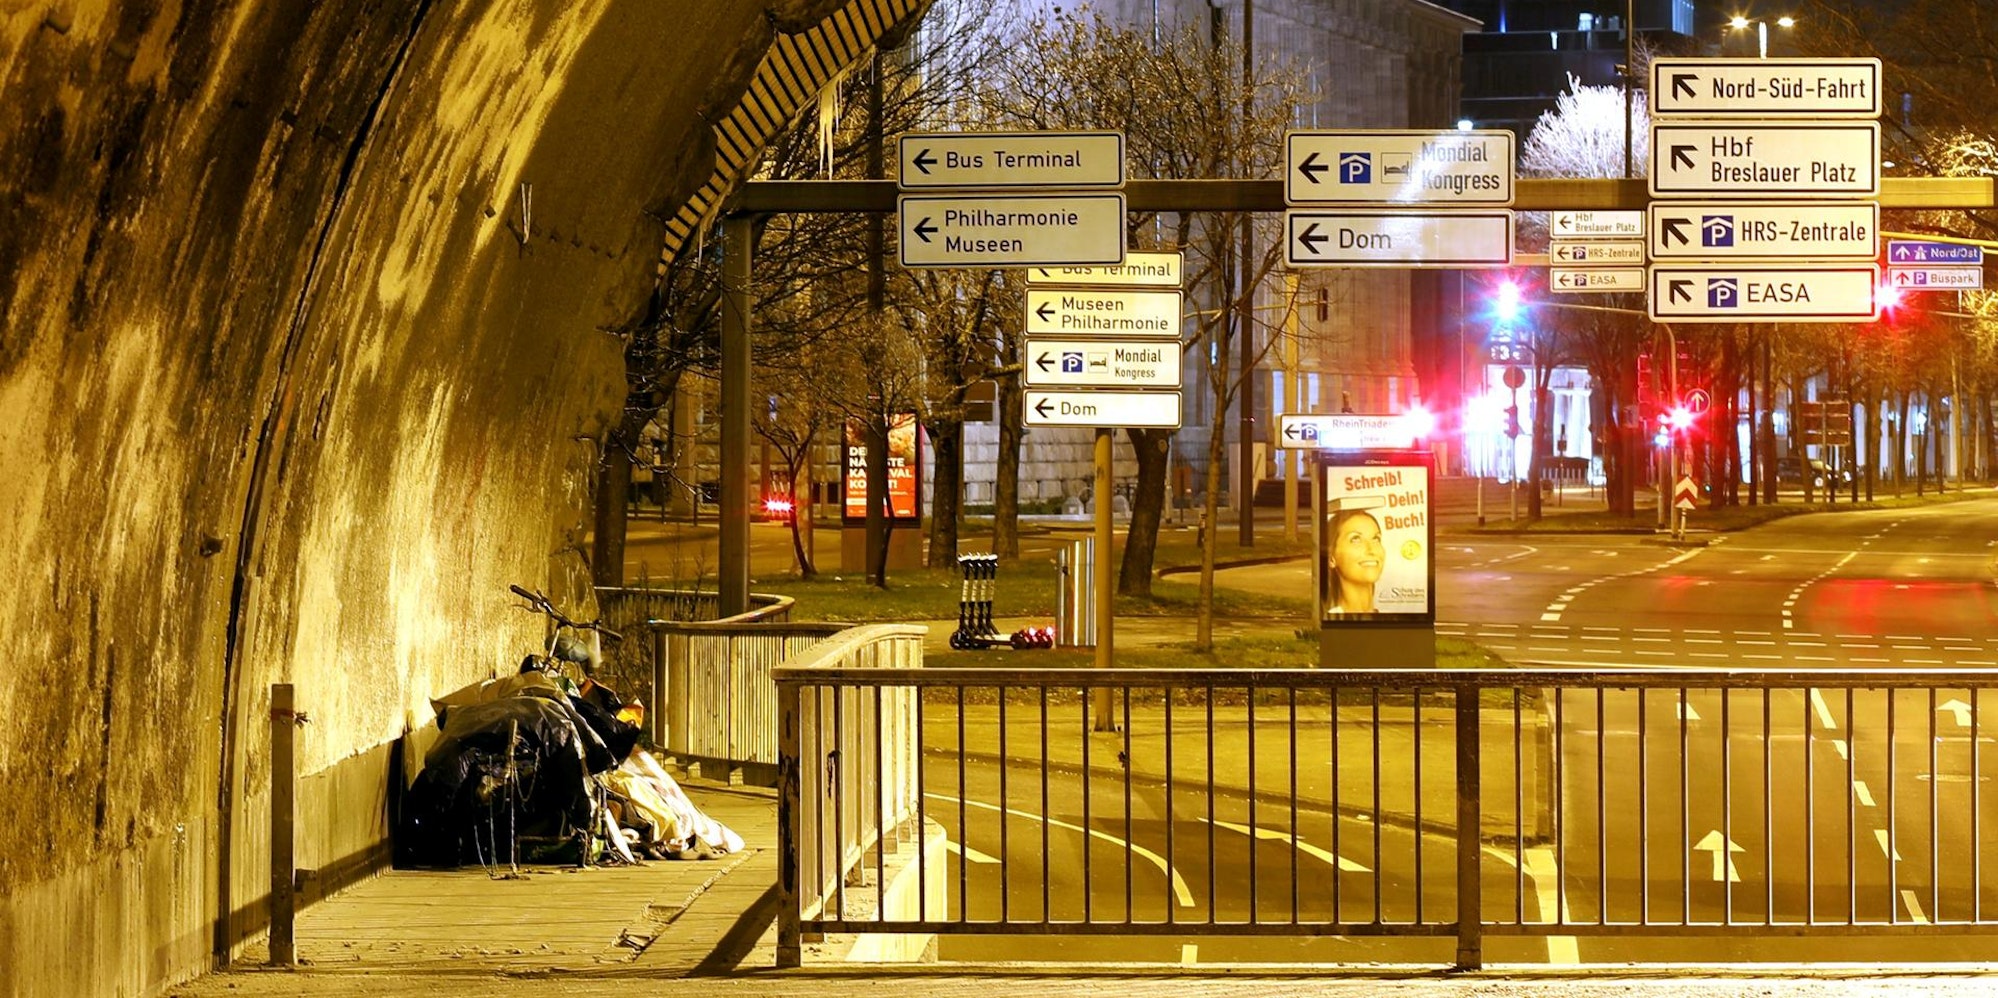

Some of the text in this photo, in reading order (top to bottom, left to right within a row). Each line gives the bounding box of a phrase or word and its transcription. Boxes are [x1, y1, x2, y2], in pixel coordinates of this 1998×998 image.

[1712, 77, 1866, 98] Nord-Süd-Fahrt
[1421, 140, 1488, 162] Mondial
[1711, 136, 1754, 157] Hbf
[946, 150, 1082, 168] Bus Terminal
[1711, 161, 1857, 182] Breslauer Platz
[1421, 170, 1500, 195] Kongress
[944, 209, 1079, 226] Philharmonie
[1575, 213, 1593, 222] Hbf
[1575, 222, 1636, 232] Breslauer Platz
[1742, 220, 1867, 241] HRS-Zentrale
[944, 235, 1023, 252] Museen
[1339, 228, 1392, 249] Dom
[1588, 248, 1640, 258] HRS-Zentrale
[1590, 275, 1617, 285] EASA
[1930, 273, 1975, 284] Buspark
[1747, 282, 1811, 303] EASA
[1062, 296, 1124, 311] Museen
[1062, 314, 1169, 330] Philharmonie
[1115, 348, 1162, 363] Mondial
[1115, 367, 1156, 380] Kongress
[1061, 401, 1097, 415] Dom
[1332, 418, 1394, 429] RheinTriade
[849, 446, 867, 456] DE
[849, 456, 904, 467] NÄTE
[849, 468, 912, 478] KAVAL
[1344, 471, 1403, 491] Schreib!
[849, 479, 898, 489] KOT!
[1388, 490, 1425, 508] Dein!
[1384, 512, 1425, 531] Buch!
